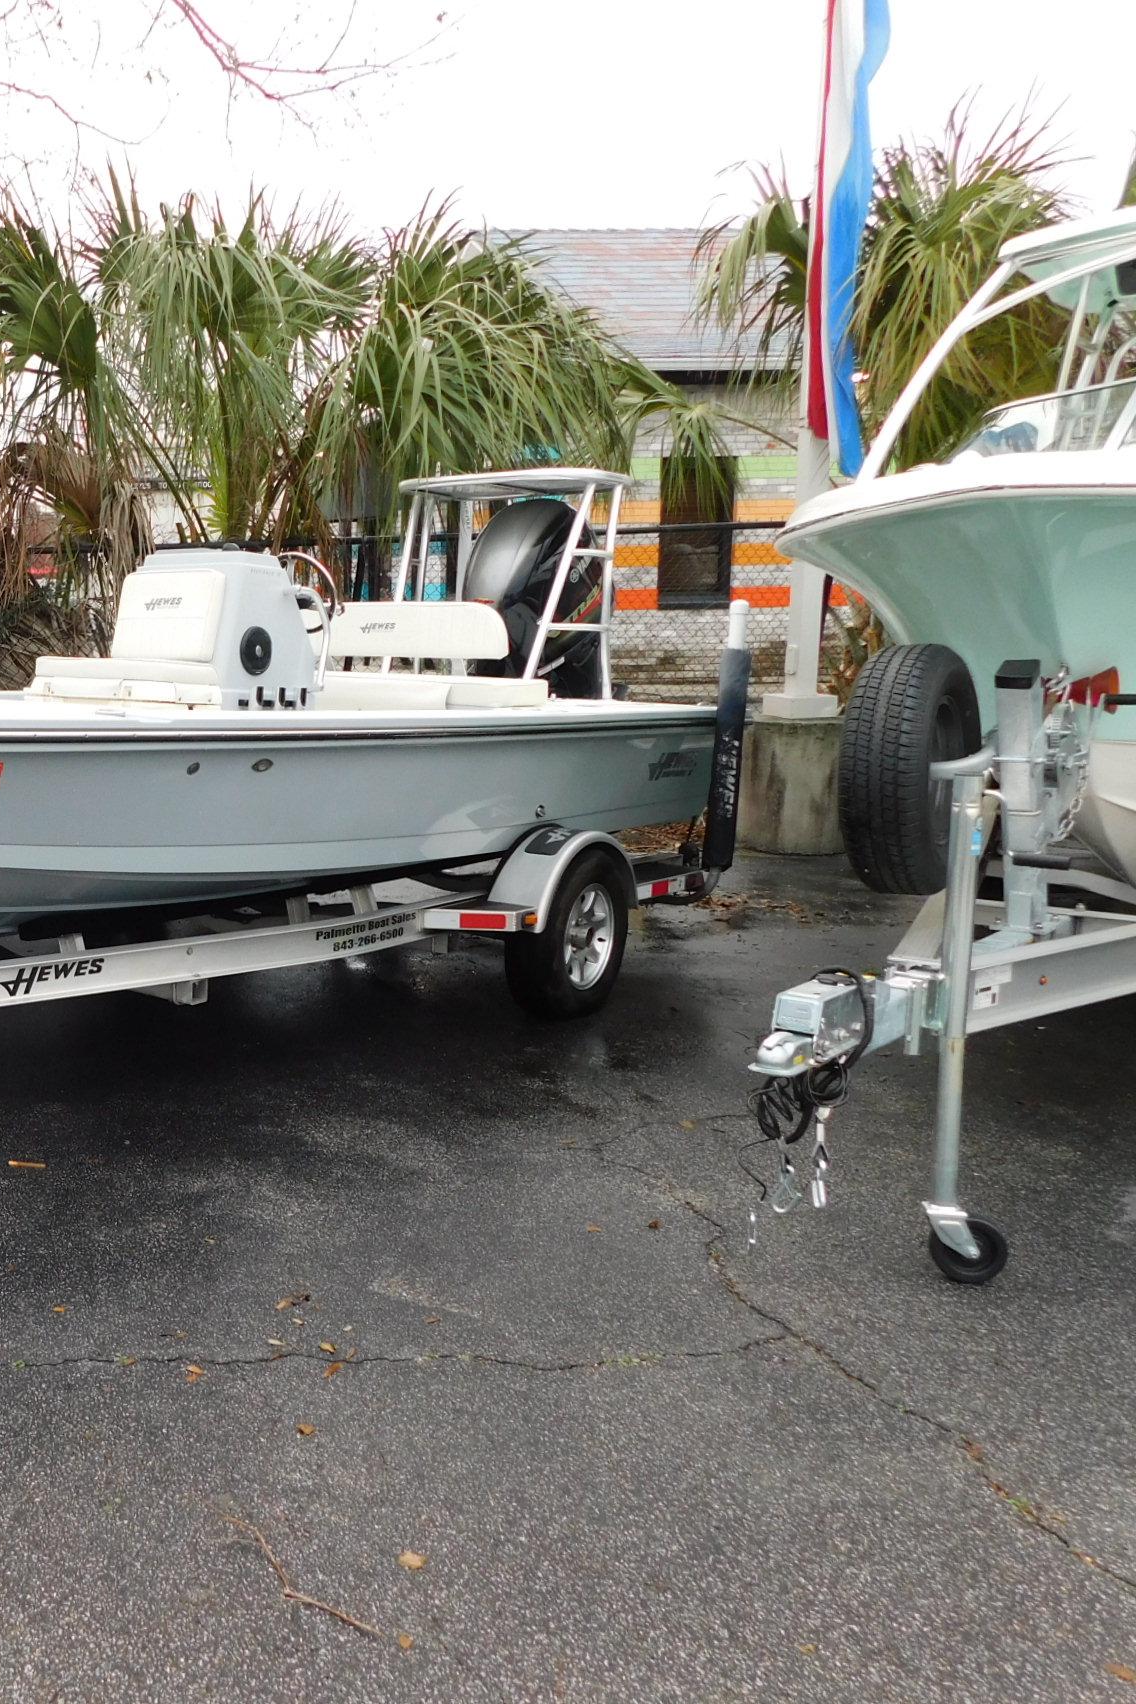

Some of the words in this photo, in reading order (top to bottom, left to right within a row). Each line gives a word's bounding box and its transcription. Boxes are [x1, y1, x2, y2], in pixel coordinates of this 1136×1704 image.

[144, 597, 182, 611] HEWES
[360, 622, 396, 634] HEWES
[315, 922, 366, 941] Palmetto
[367, 917, 390, 932] Boat
[391, 911, 417, 926] Sales
[332, 926, 404, 952] 843-266-6500
